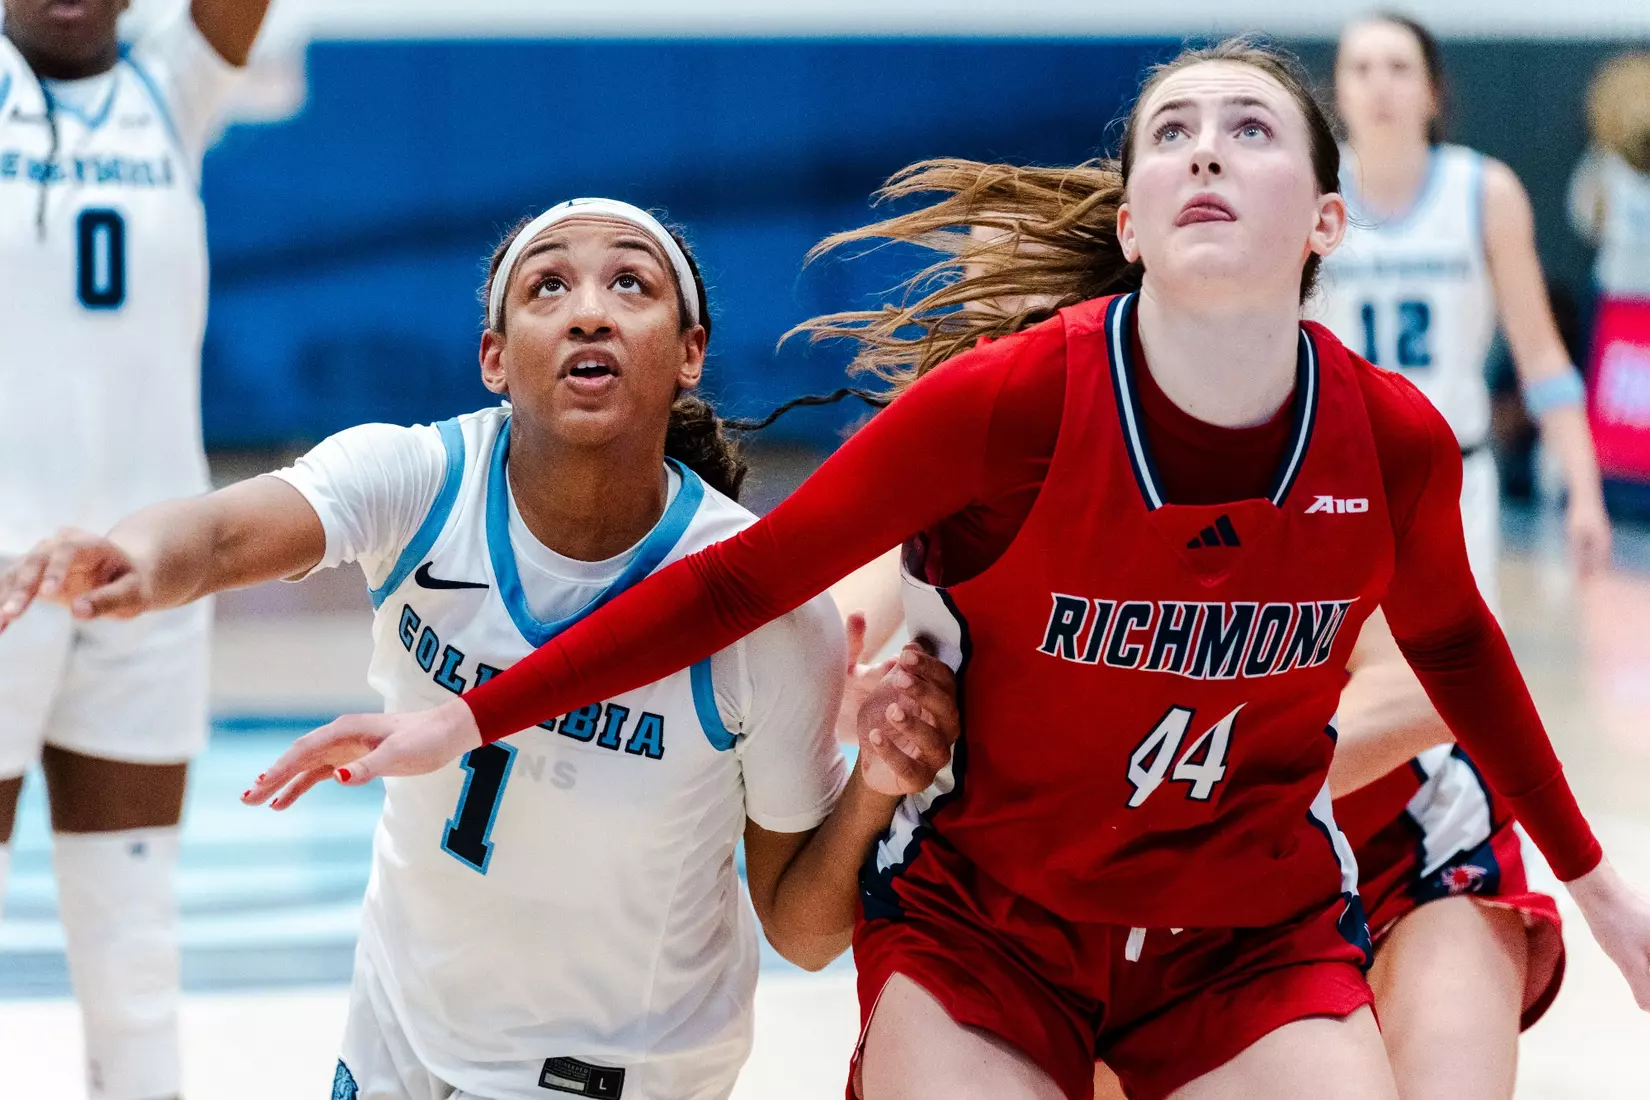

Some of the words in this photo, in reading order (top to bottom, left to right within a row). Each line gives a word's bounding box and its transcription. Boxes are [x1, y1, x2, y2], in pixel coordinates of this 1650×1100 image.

[77, 208, 126, 309] 0
[1361, 300, 1432, 367] 12
[1304, 495, 1369, 514] A10
[398, 603, 665, 760] COLBIA
[1036, 592, 1360, 680] RICHMOND
[1125, 702, 1248, 809] 44
[440, 740, 518, 876] 1
[599, 1077, 607, 1091] L
